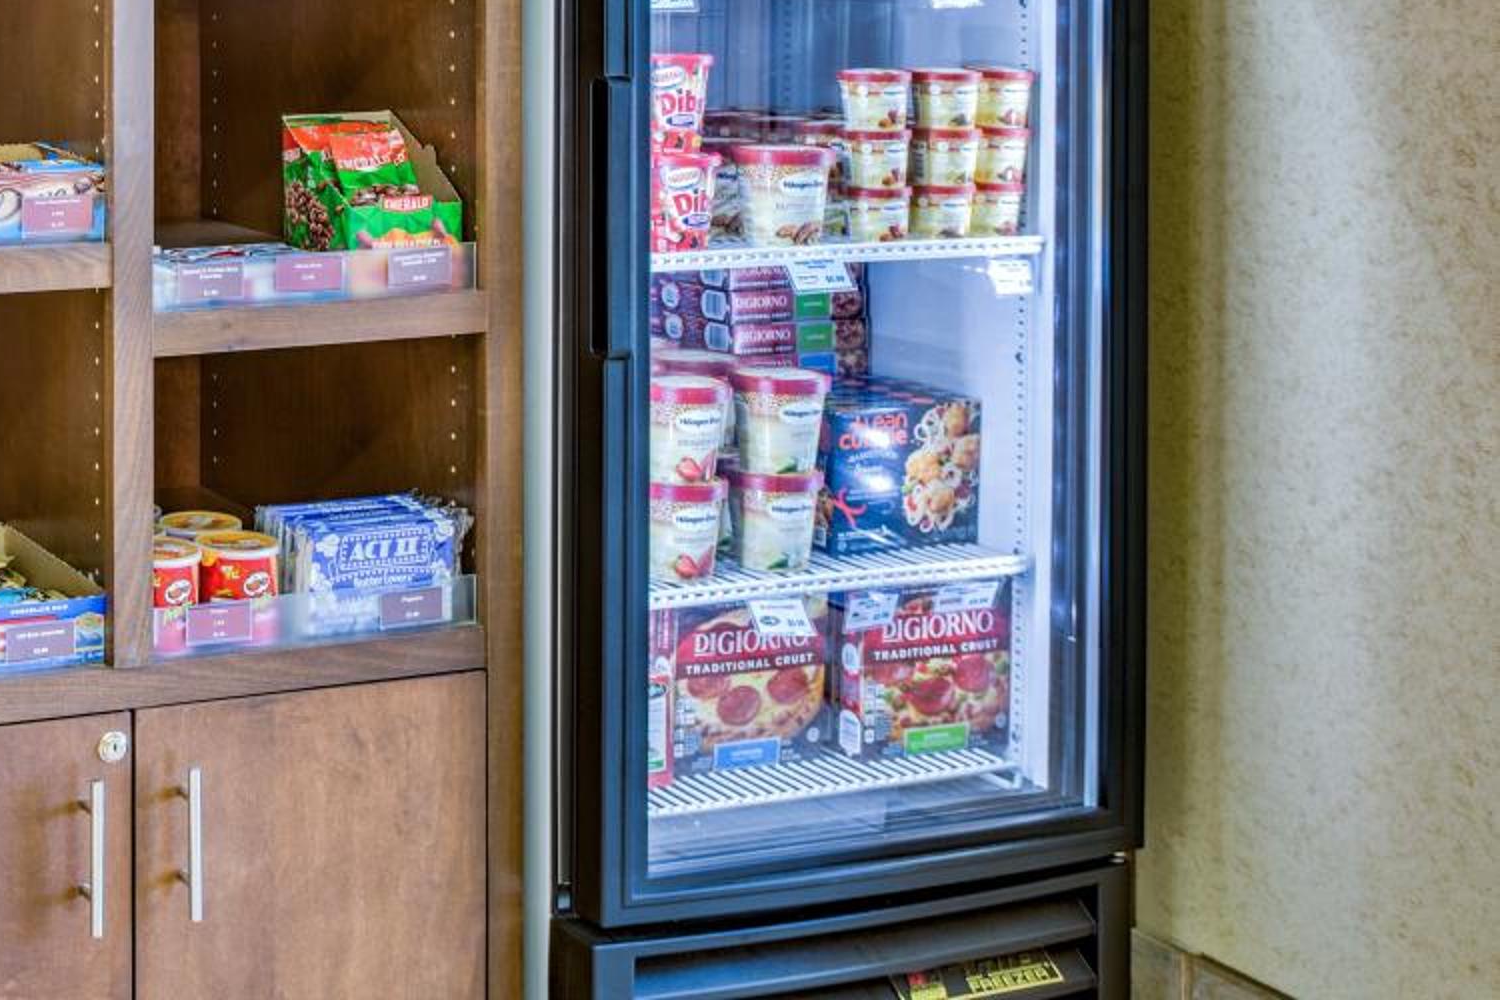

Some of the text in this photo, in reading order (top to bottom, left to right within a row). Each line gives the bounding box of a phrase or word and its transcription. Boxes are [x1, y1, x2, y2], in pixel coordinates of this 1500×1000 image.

[351, 536, 419, 561] ACT II
[883, 611, 995, 643] DIGIORNO
[873, 638, 999, 661] TRADITIONAL CRUST
[686, 652, 814, 676] TRADITIONAL CRUST
